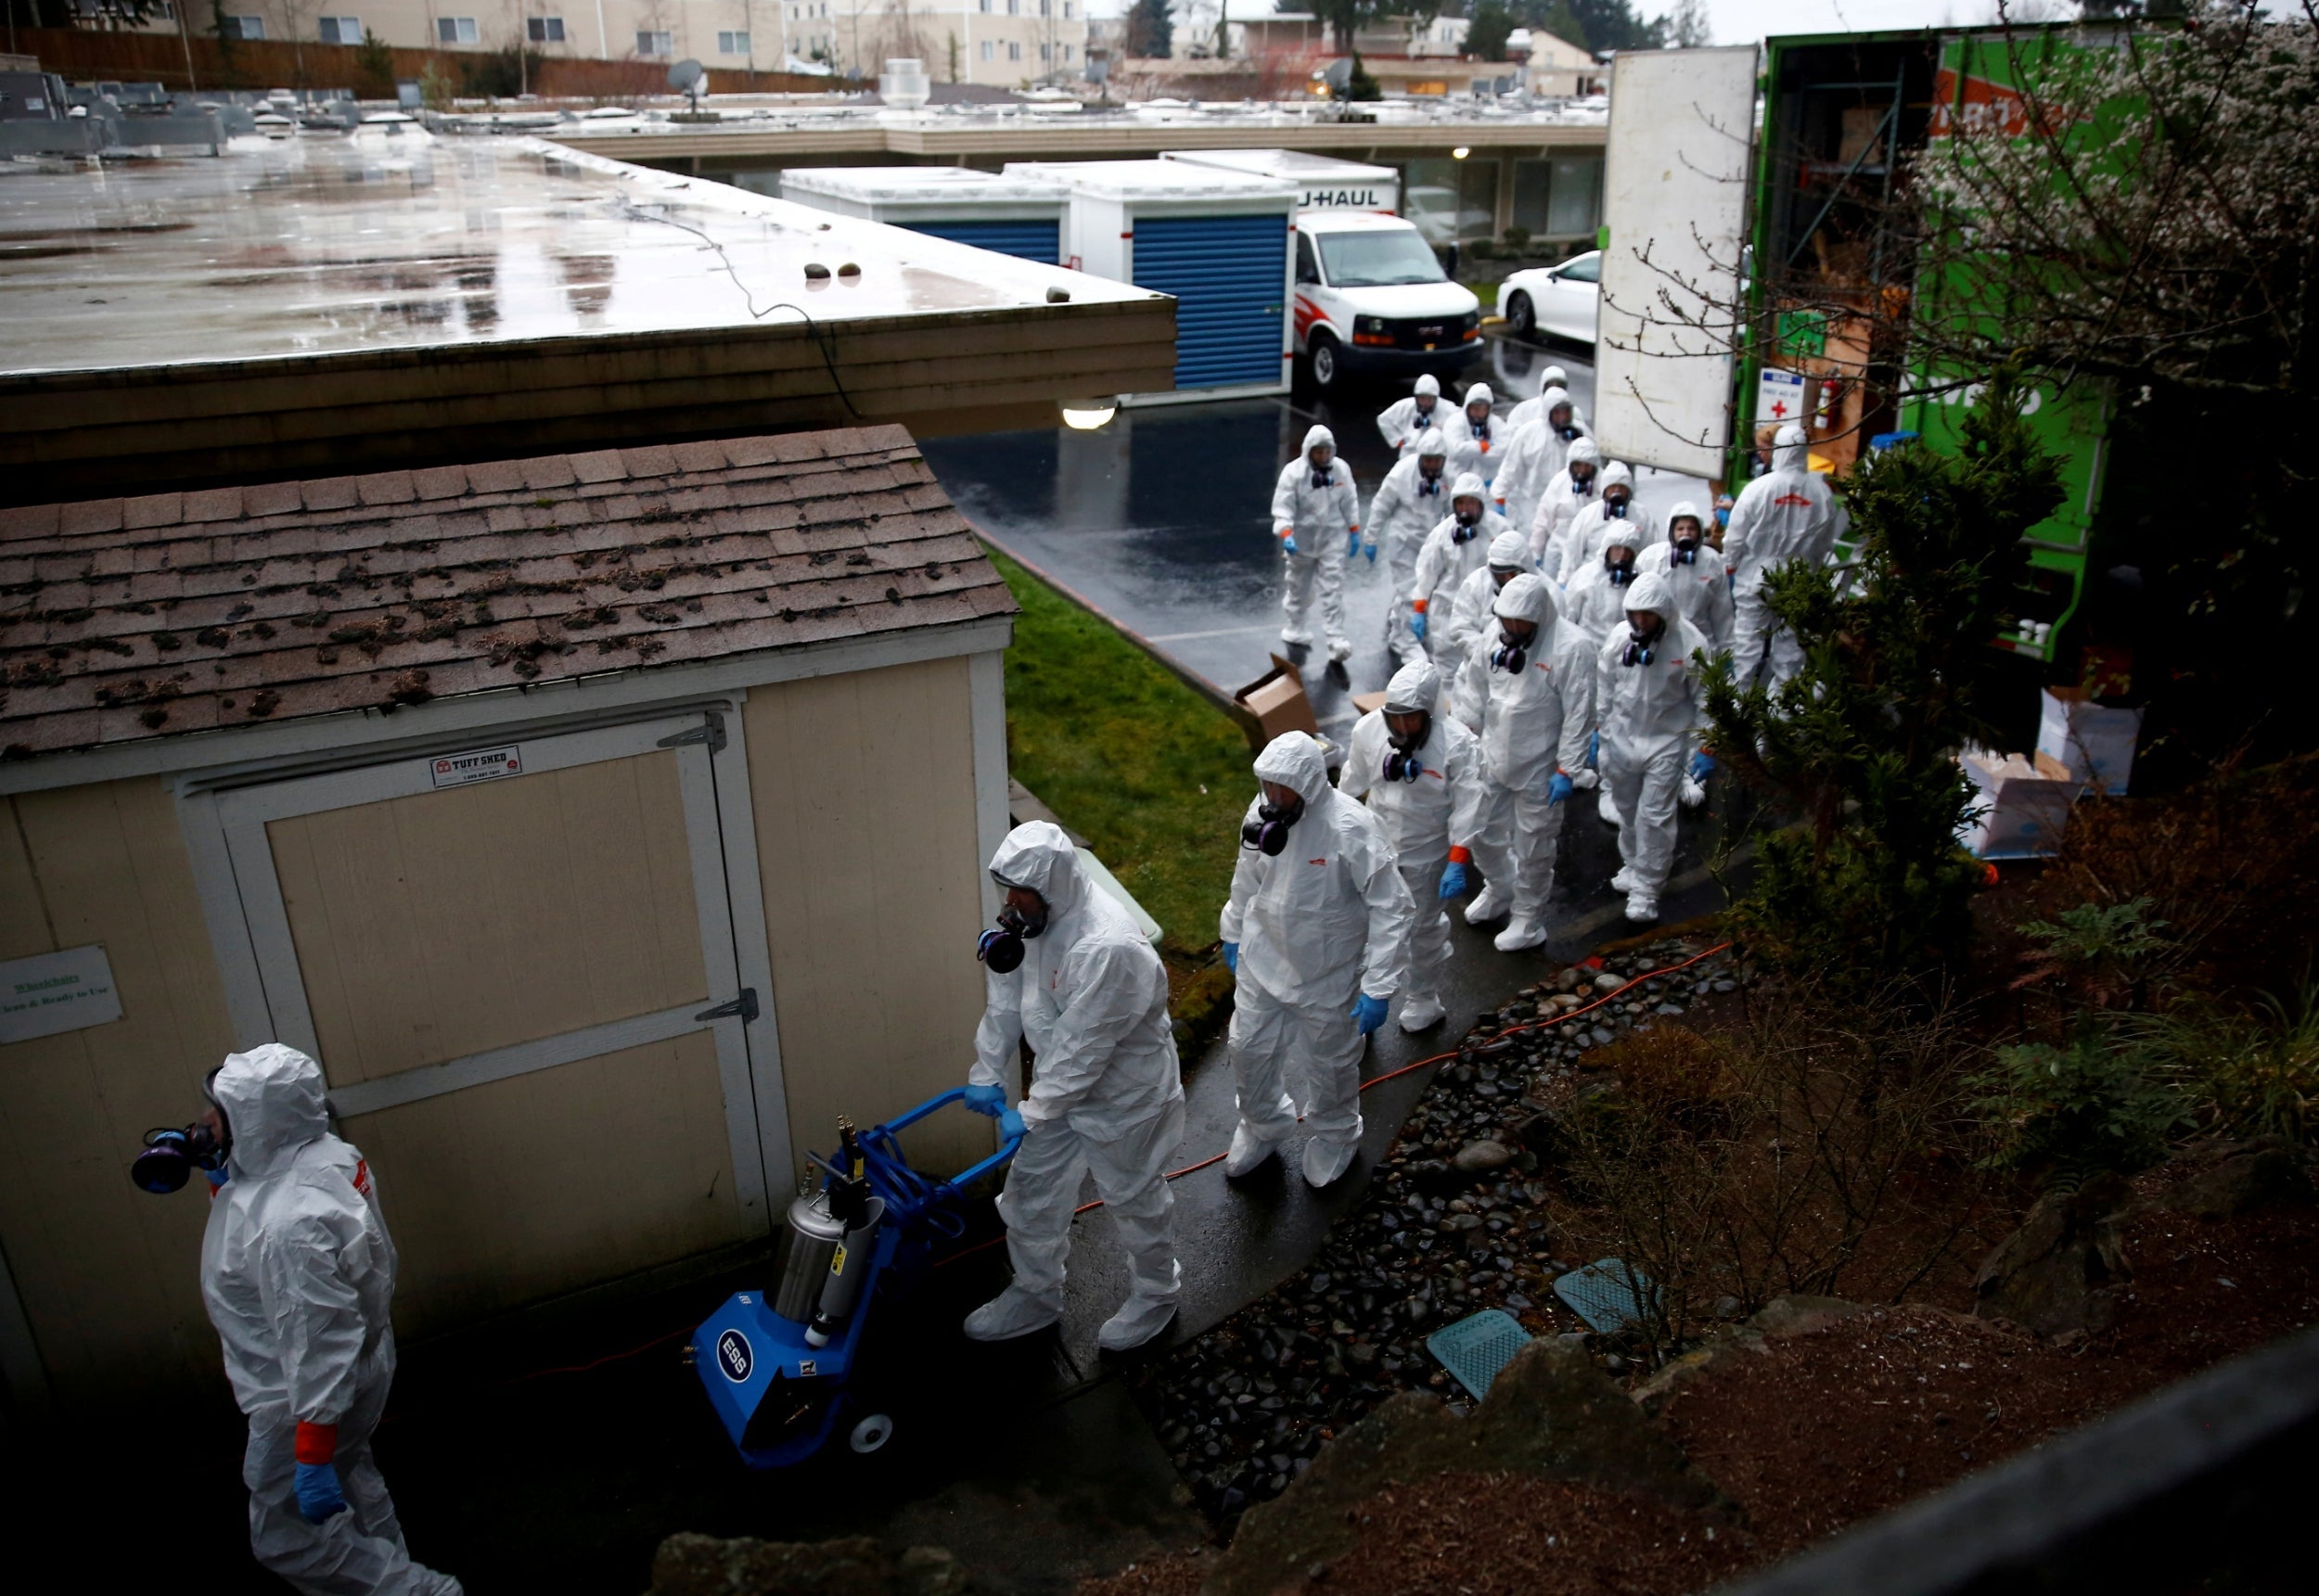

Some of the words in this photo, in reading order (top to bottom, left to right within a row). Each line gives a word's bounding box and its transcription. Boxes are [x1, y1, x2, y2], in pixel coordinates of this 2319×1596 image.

[452, 757, 480, 770] TUFF
[480, 753, 506, 765] SHED
[0, 1003, 26, 1013] lean
[42, 993, 74, 1005] Ready
[89, 987, 109, 995] Use
[723, 1337, 747, 1374] ESS
